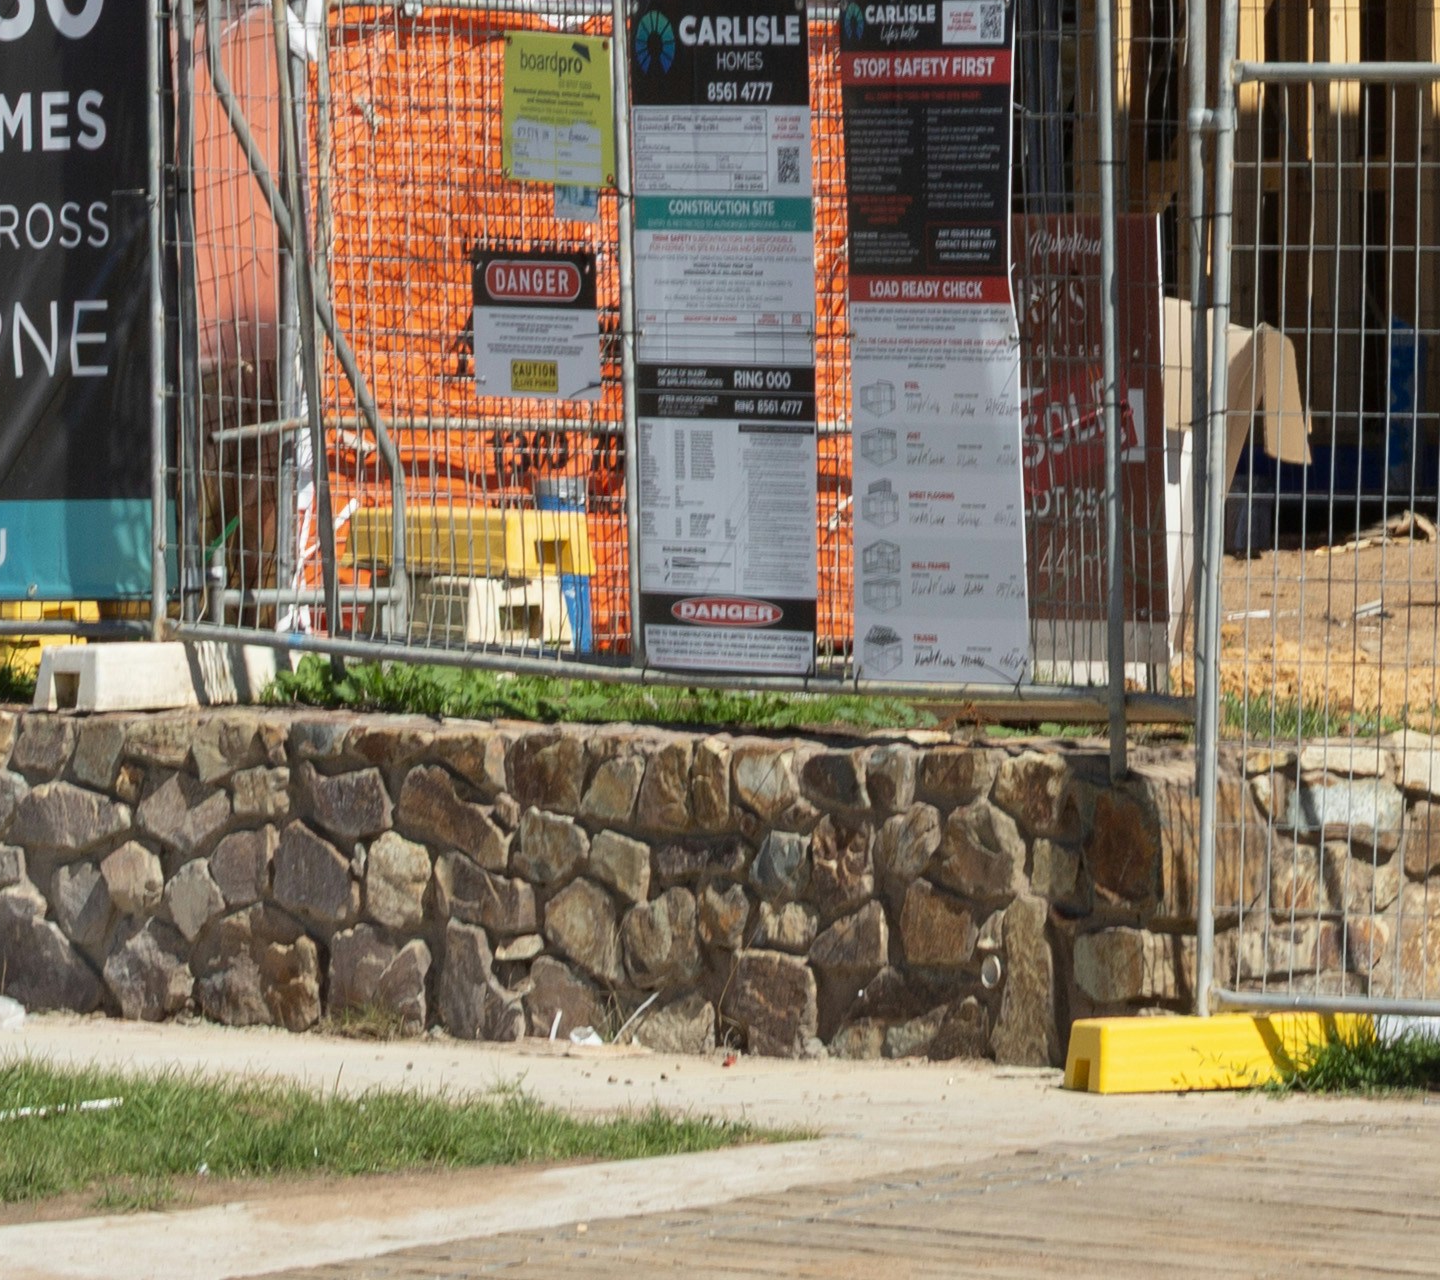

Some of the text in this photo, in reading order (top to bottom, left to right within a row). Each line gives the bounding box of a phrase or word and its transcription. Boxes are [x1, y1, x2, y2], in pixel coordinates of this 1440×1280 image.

[865, 4, 936, 24] CARLISLE
[679, 15, 800, 46] CARLISLE
[520, 48, 583, 77] boardpro
[716, 51, 764, 71] HOMES
[853, 56, 996, 78] STOP! SAFETY FIRST
[707, 81, 773, 102] 8561 4777
[668, 199, 775, 216] CONSTRUCTION SITE
[495, 268, 569, 295] DANGER
[870, 281, 983, 299] LOAD READY CHECK
[512, 362, 556, 376] CAUTION
[733, 370, 791, 389] RING 000
[734, 400, 803, 415] RING 8561 4777
[680, 602, 774, 623] DANGER
